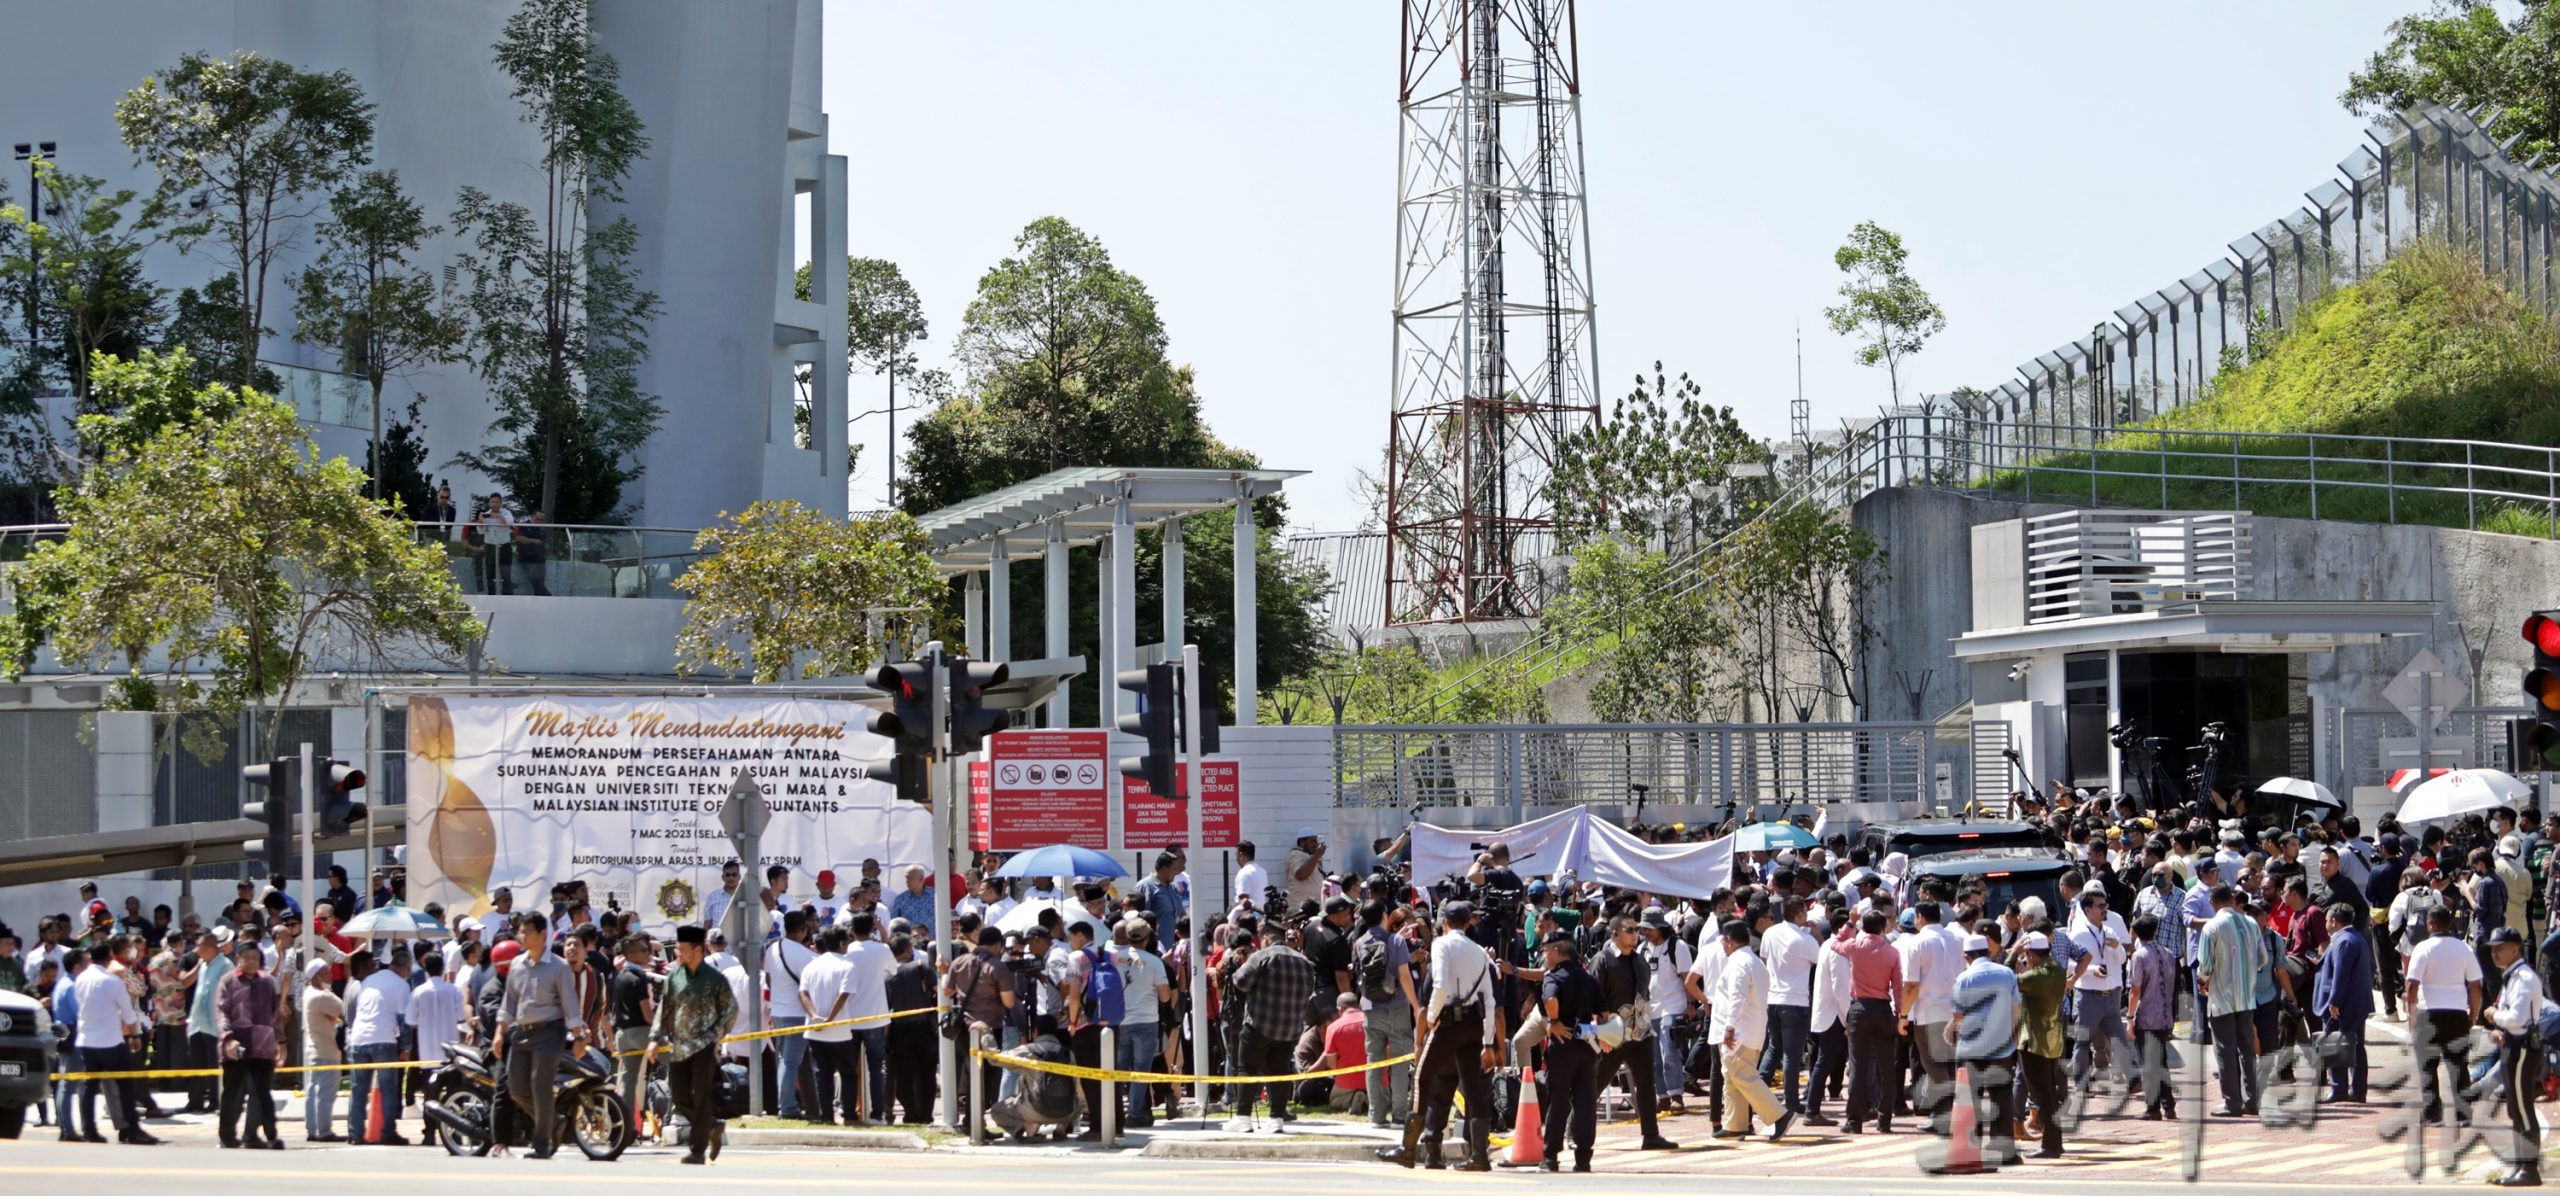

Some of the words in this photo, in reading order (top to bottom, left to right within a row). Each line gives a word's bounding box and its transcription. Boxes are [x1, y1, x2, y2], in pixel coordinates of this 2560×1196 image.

[526, 711, 619, 745] Majlis
[627, 711, 846, 747] Menandatangani
[532, 747, 642, 760] MEMORANDUM
[653, 748, 772, 760] PERSEFAHAMAN
[784, 748, 840, 761] ANTARA
[497, 765, 606, 777] SURUHANJAYA
[617, 765, 720, 777] PENCEGAHAN
[731, 766, 789, 777] RSUAH
[1205, 776, 1216, 784] AND
[524, 783, 586, 795] DENGAN
[596, 783, 678, 795] UNIVERSITI
[689, 783, 776, 796] TEKNGI
[787, 784, 827, 796] MARA
[838, 785, 847, 796] &
[1218, 784, 1234, 792] PLACE
[533, 799, 618, 811] MALAYSIAN
[625, 799, 698, 812] INSTITUTE
[704, 800, 722, 812] OF
[631, 829, 636, 838] 7
[640, 829, 662, 839] MAC
[665, 829, 691, 838] 2023
[572, 856, 632, 865] AUDITORIUM
[635, 856, 665, 866] SPRM,
[668, 856, 694, 865] ARAS
[709, 856, 724, 865] IBU
[775, 856, 802, 865] SPRM
